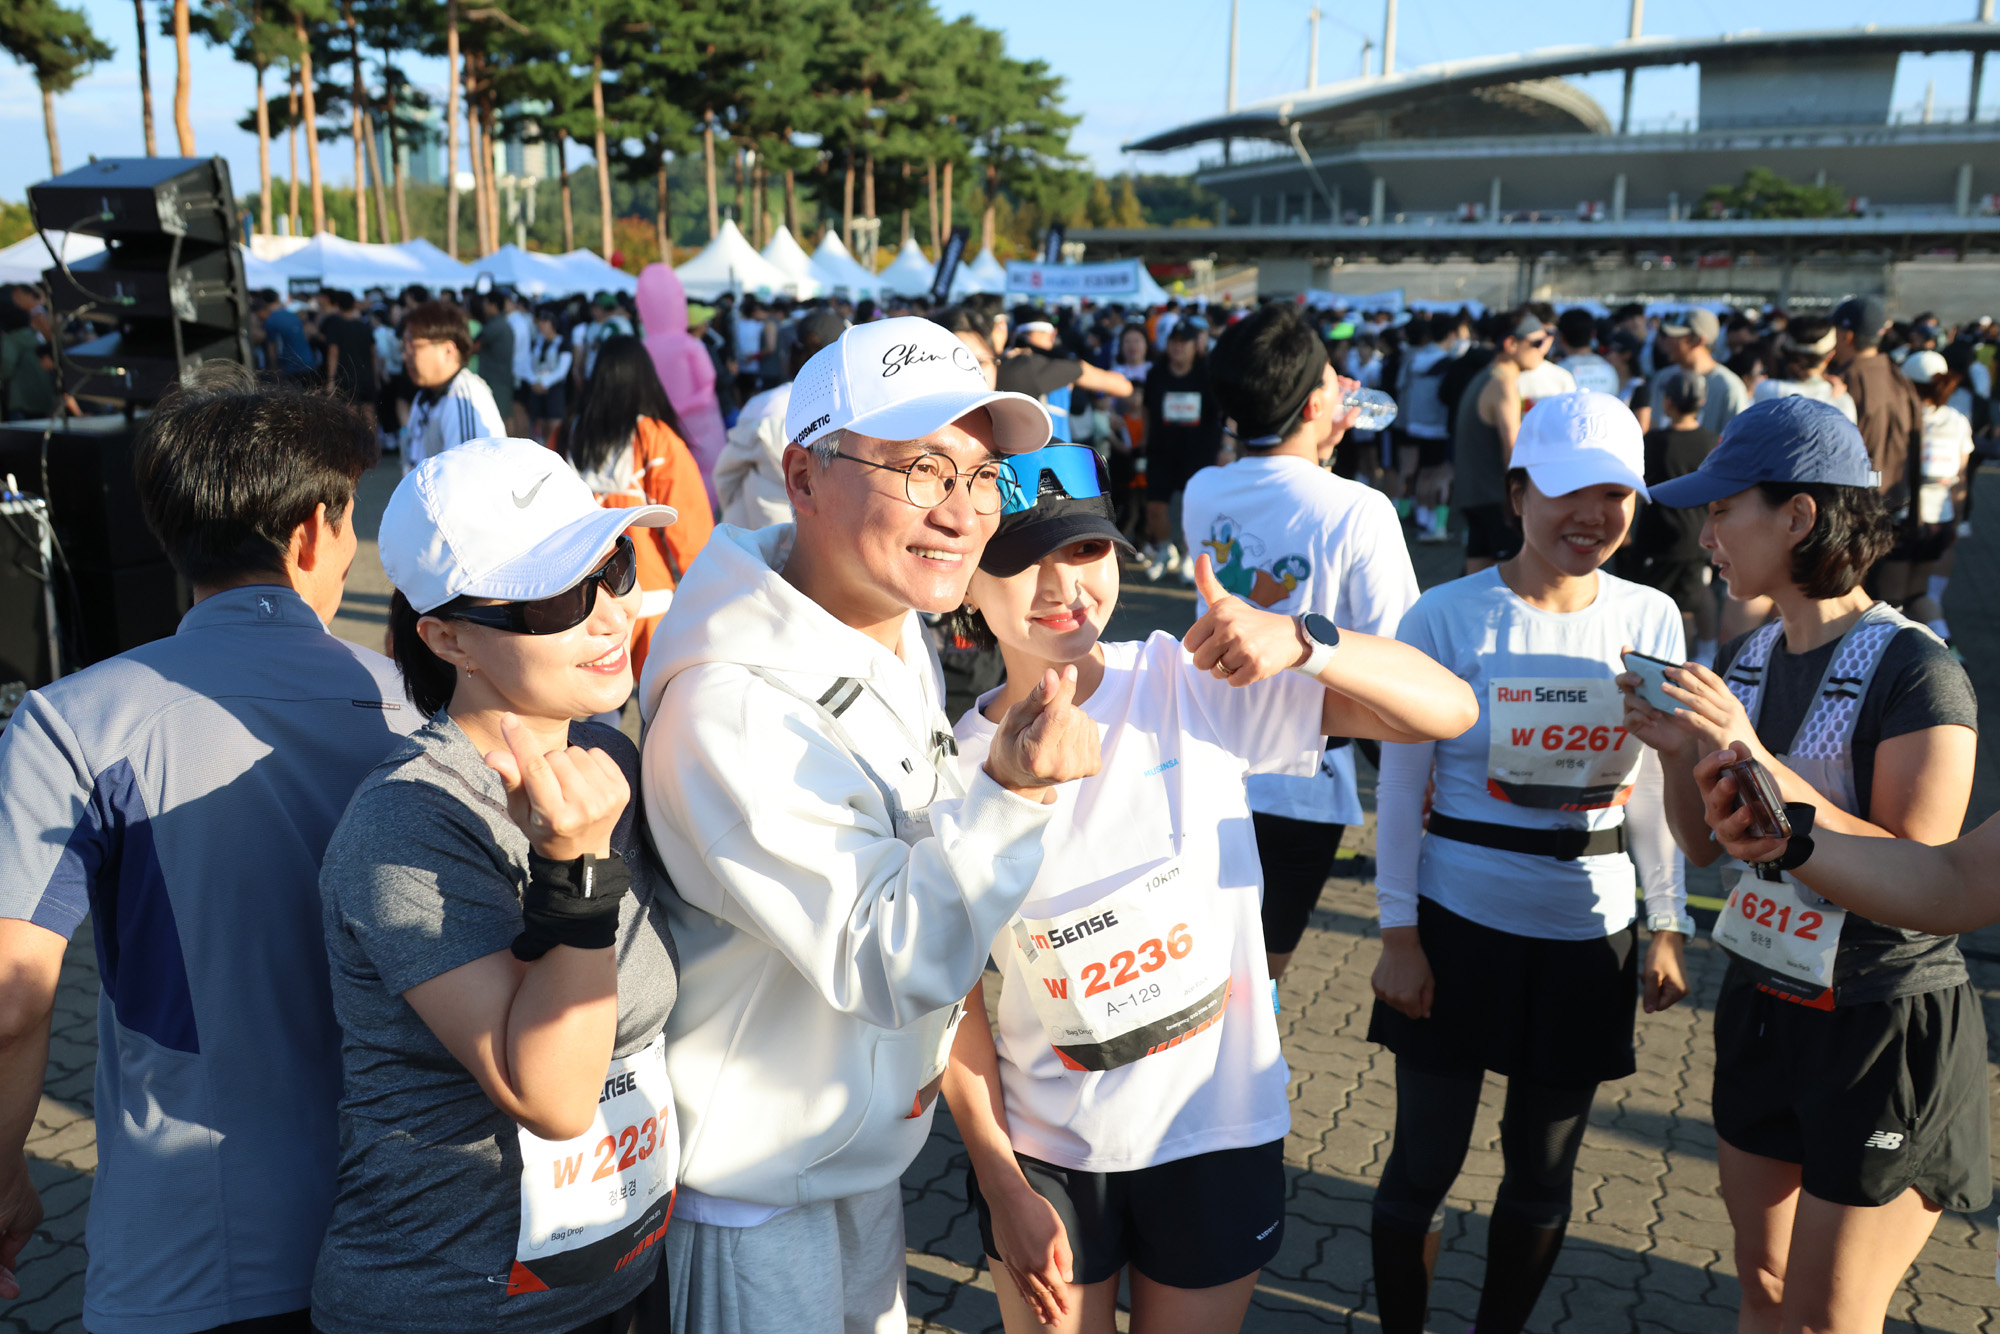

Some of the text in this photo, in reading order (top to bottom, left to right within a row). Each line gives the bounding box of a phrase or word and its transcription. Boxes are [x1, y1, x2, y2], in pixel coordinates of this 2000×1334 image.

[882, 343, 947, 378] Skin
[798, 413, 831, 443] COSMETIC
[1511, 725, 1629, 751] W 6267
[1143, 758, 1180, 777] MUSINSA
[1145, 867, 1180, 893] 10km
[1741, 891, 1823, 941] 6212
[1043, 922, 1193, 1000] W 2236
[1107, 983, 1161, 1016] A-129
[553, 1105, 668, 1189] W 2237
[609, 1178, 637, 1206] 정보경
[551, 1225, 584, 1242] Bag Drop
